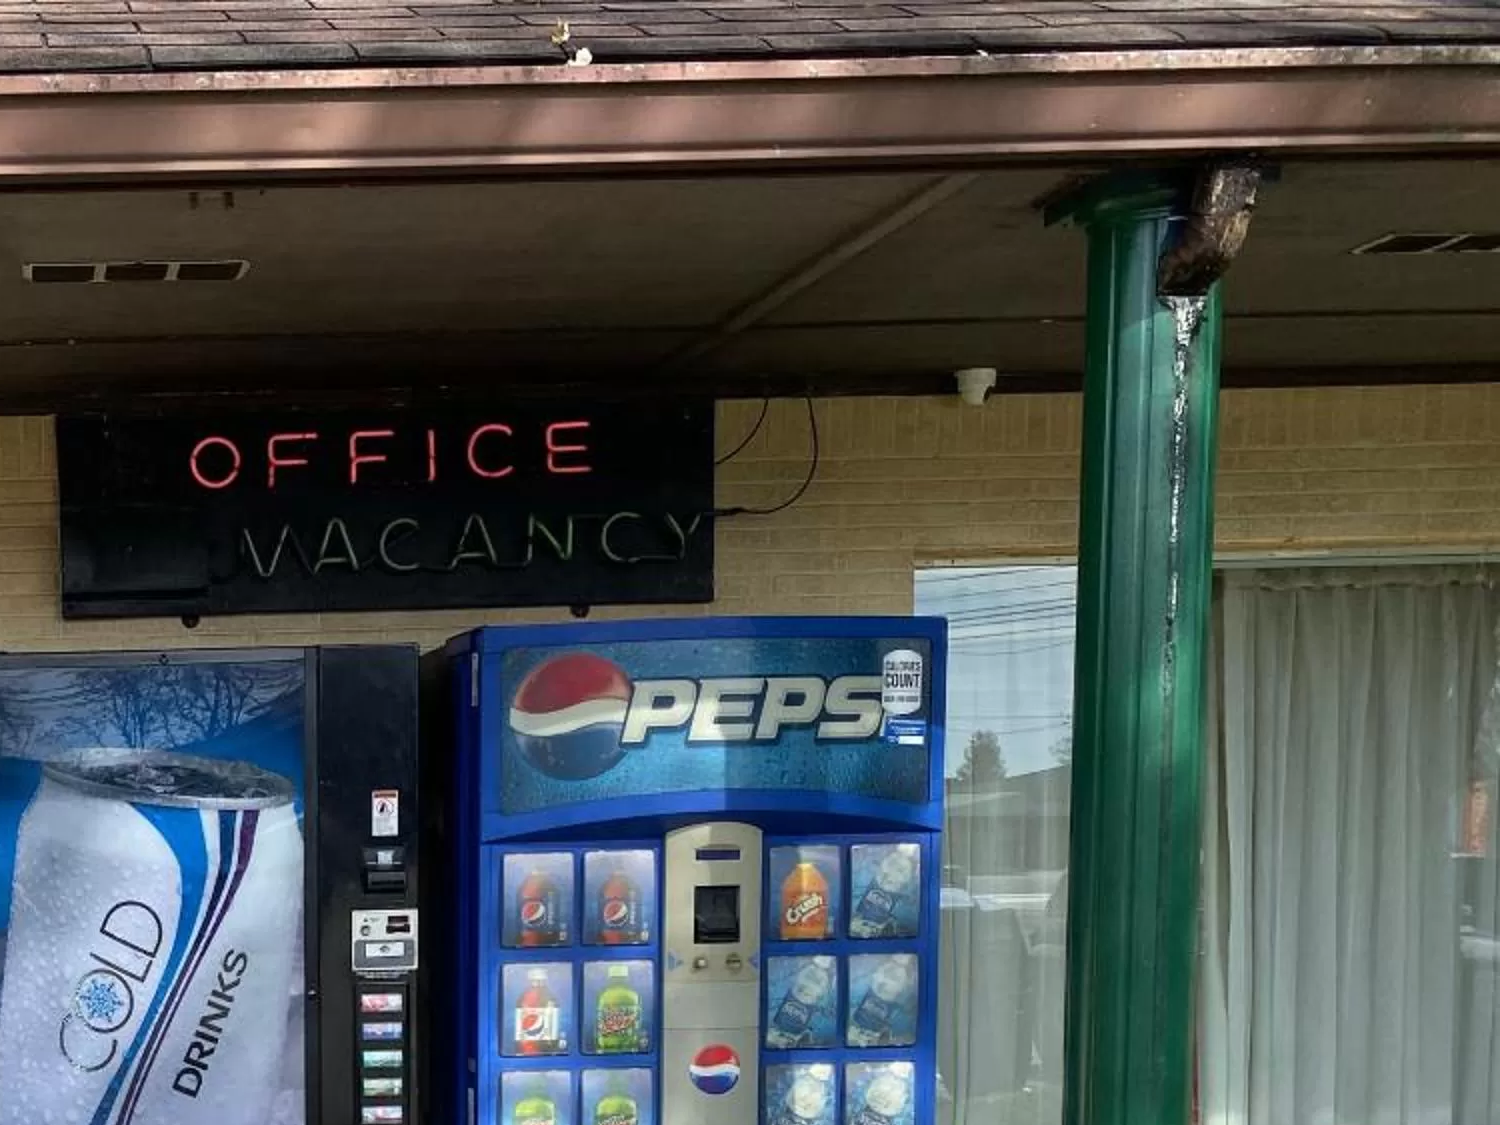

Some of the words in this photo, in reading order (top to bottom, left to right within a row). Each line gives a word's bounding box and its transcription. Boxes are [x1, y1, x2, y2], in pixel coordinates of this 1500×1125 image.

[189, 421, 593, 488] OFFICE
[240, 510, 701, 577] VACANCY
[620, 675, 888, 744] PEPS
[884, 673, 921, 688] COUNT
[60, 900, 163, 1072] COLD
[172, 949, 248, 1098] DRINKS
